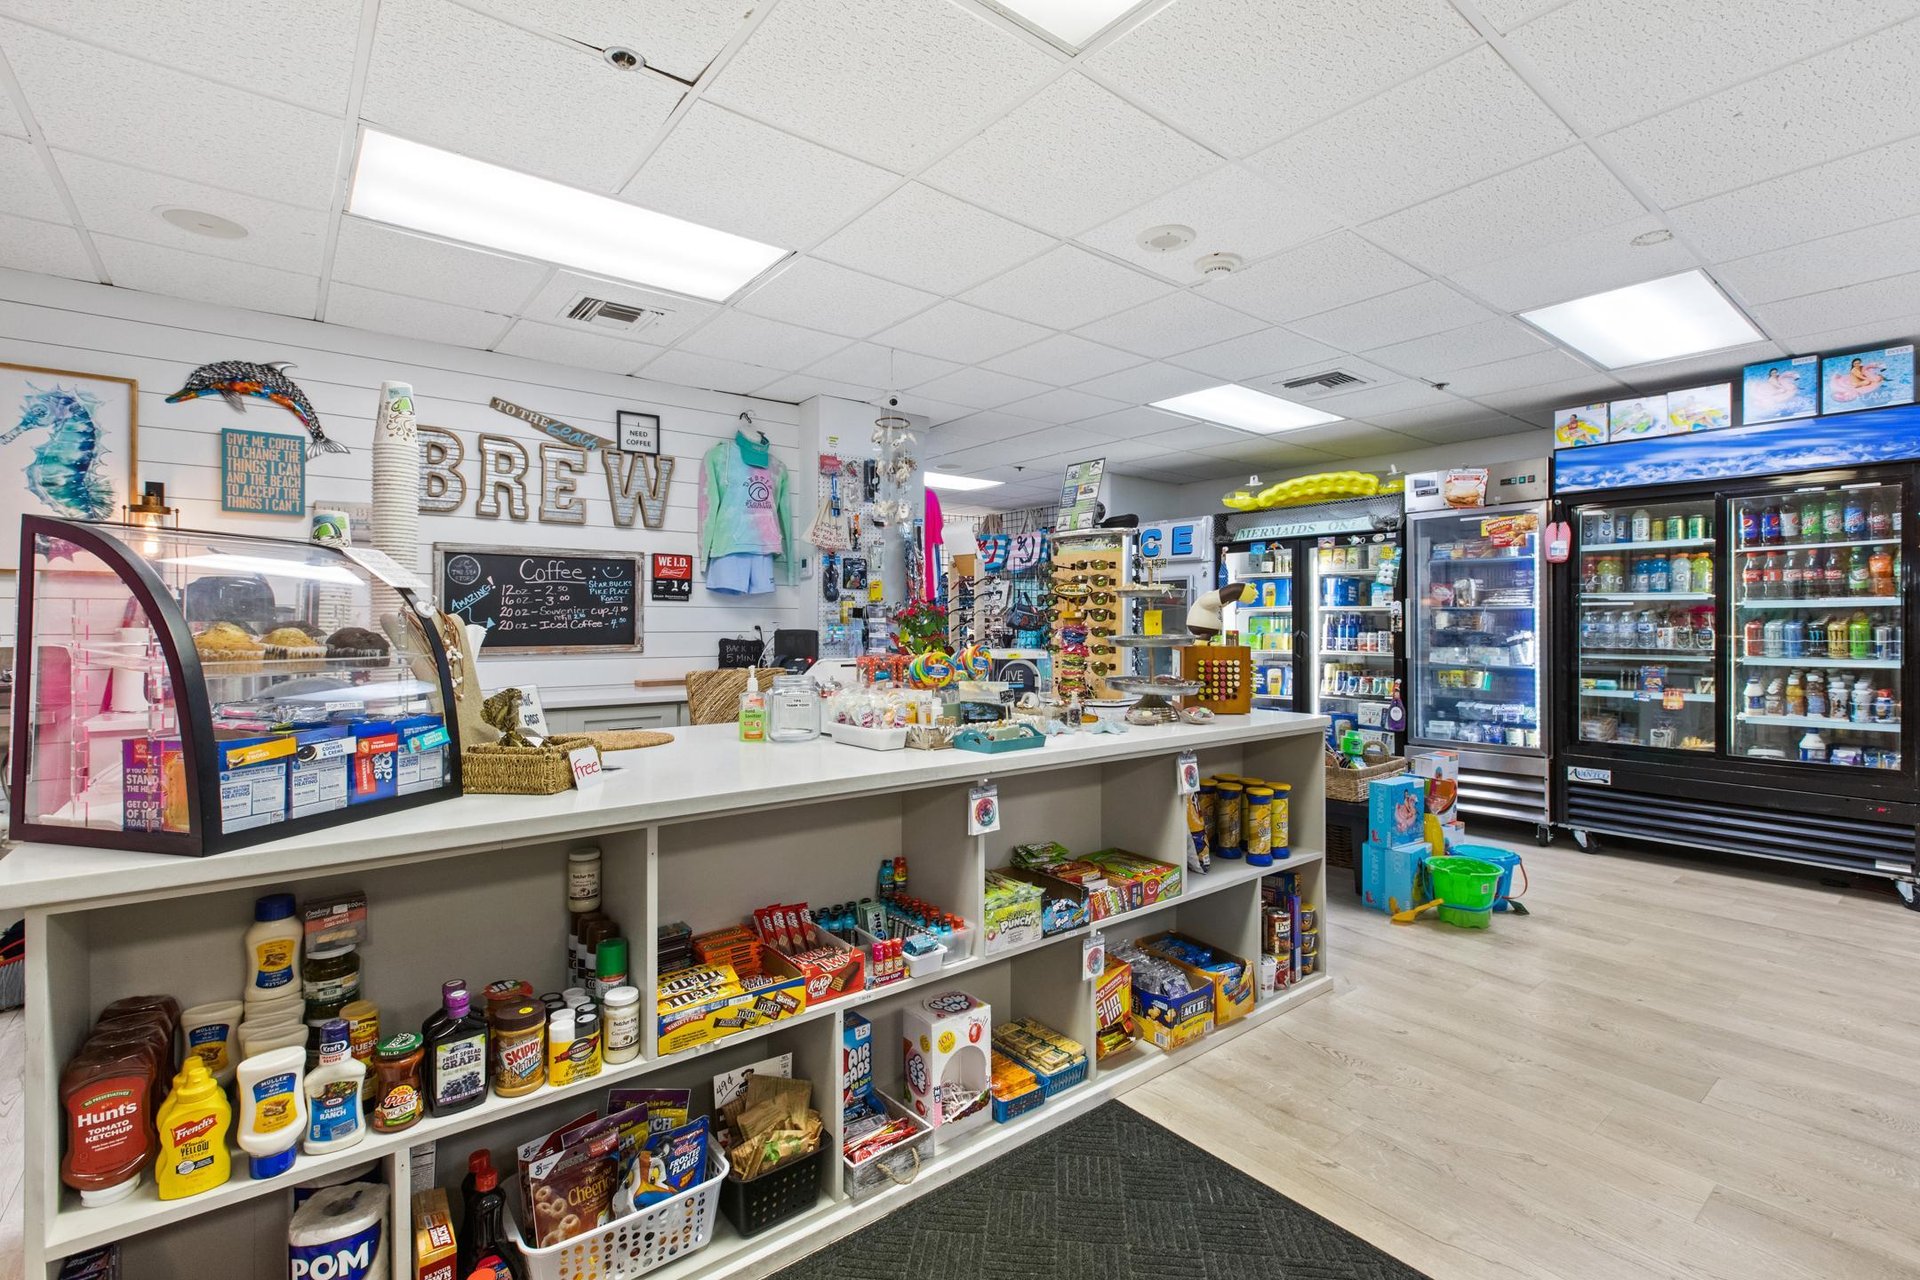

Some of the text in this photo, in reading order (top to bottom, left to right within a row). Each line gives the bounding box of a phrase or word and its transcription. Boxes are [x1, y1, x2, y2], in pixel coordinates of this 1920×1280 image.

[496, 400, 597, 450] TO THE beach
[226, 433, 301, 450] GIVE ME COFFEE
[629, 430, 648, 438] NEED
[626, 438, 651, 447] COFFEE
[227, 445, 300, 463] TO CHANGE THE
[227, 457, 267, 473] THINGS
[278, 462, 300, 475] CAN
[227, 472, 301, 488] AND THE BEACH
[416, 424, 675, 528] BREW
[227, 484, 301, 499] TO ACCEPT THE
[227, 496, 262, 509] THINGS
[272, 499, 300, 512] CAN'T
[1239, 523, 1317, 540] MERMAIDS
[1140, 524, 1194, 558] CE
[520, 559, 586, 580] Coffee
[658, 556, 688, 568] WE I.D.
[451, 576, 497, 611] AMAZING!
[539, 620, 568, 630] Iced
[570, 621, 603, 630] Coffee
[726, 645, 746, 653] BACK
[736, 655, 756, 663] MIN.
[1003, 669, 1024, 682] JIVE
[322, 743, 344, 751] COOKIES
[371, 741, 397, 750] STRAWBERRY
[126, 774, 159, 785] STAND
[1568, 767, 1610, 783] AVANTCO
[127, 785, 140, 793] THE
[294, 779, 318, 788] HEATING
[222, 791, 250, 800] HEATING
[127, 801, 141, 809] GET
[127, 810, 141, 819] OF
[1000, 914, 1033, 934] PUNCH
[930, 993, 969, 1010] BLOW
[944, 1000, 972, 1013] POP
[1183, 1004, 1195, 1017] ACT
[667, 1016, 690, 1031] VARIETY
[322, 1042, 344, 1053] Kraft
[442, 1047, 482, 1063] FRUIT SPREAD
[504, 1039, 541, 1066] SKIPPY
[442, 1053, 482, 1071] GRAPE
[848, 1042, 871, 1071] AIR
[260, 1074, 290, 1088] MÜLLER
[843, 1057, 871, 1089] EADS
[92, 1090, 130, 1103] PRESERVATIVES
[77, 1101, 138, 1128] Hunt's
[319, 1109, 347, 1121] RANCH
[323, 1106, 344, 1114] CLASSIC
[85, 1124, 133, 1144] KETCHUP
[88, 1119, 130, 1136] TOMATO
[175, 1116, 215, 1142] French's
[180, 1141, 210, 1157] YELLOW
[669, 1146, 701, 1170] FROSTED
[672, 1155, 699, 1176] FLAKES
[292, 1239, 370, 1280] POM
[434, 1264, 452, 1277] YOUR
